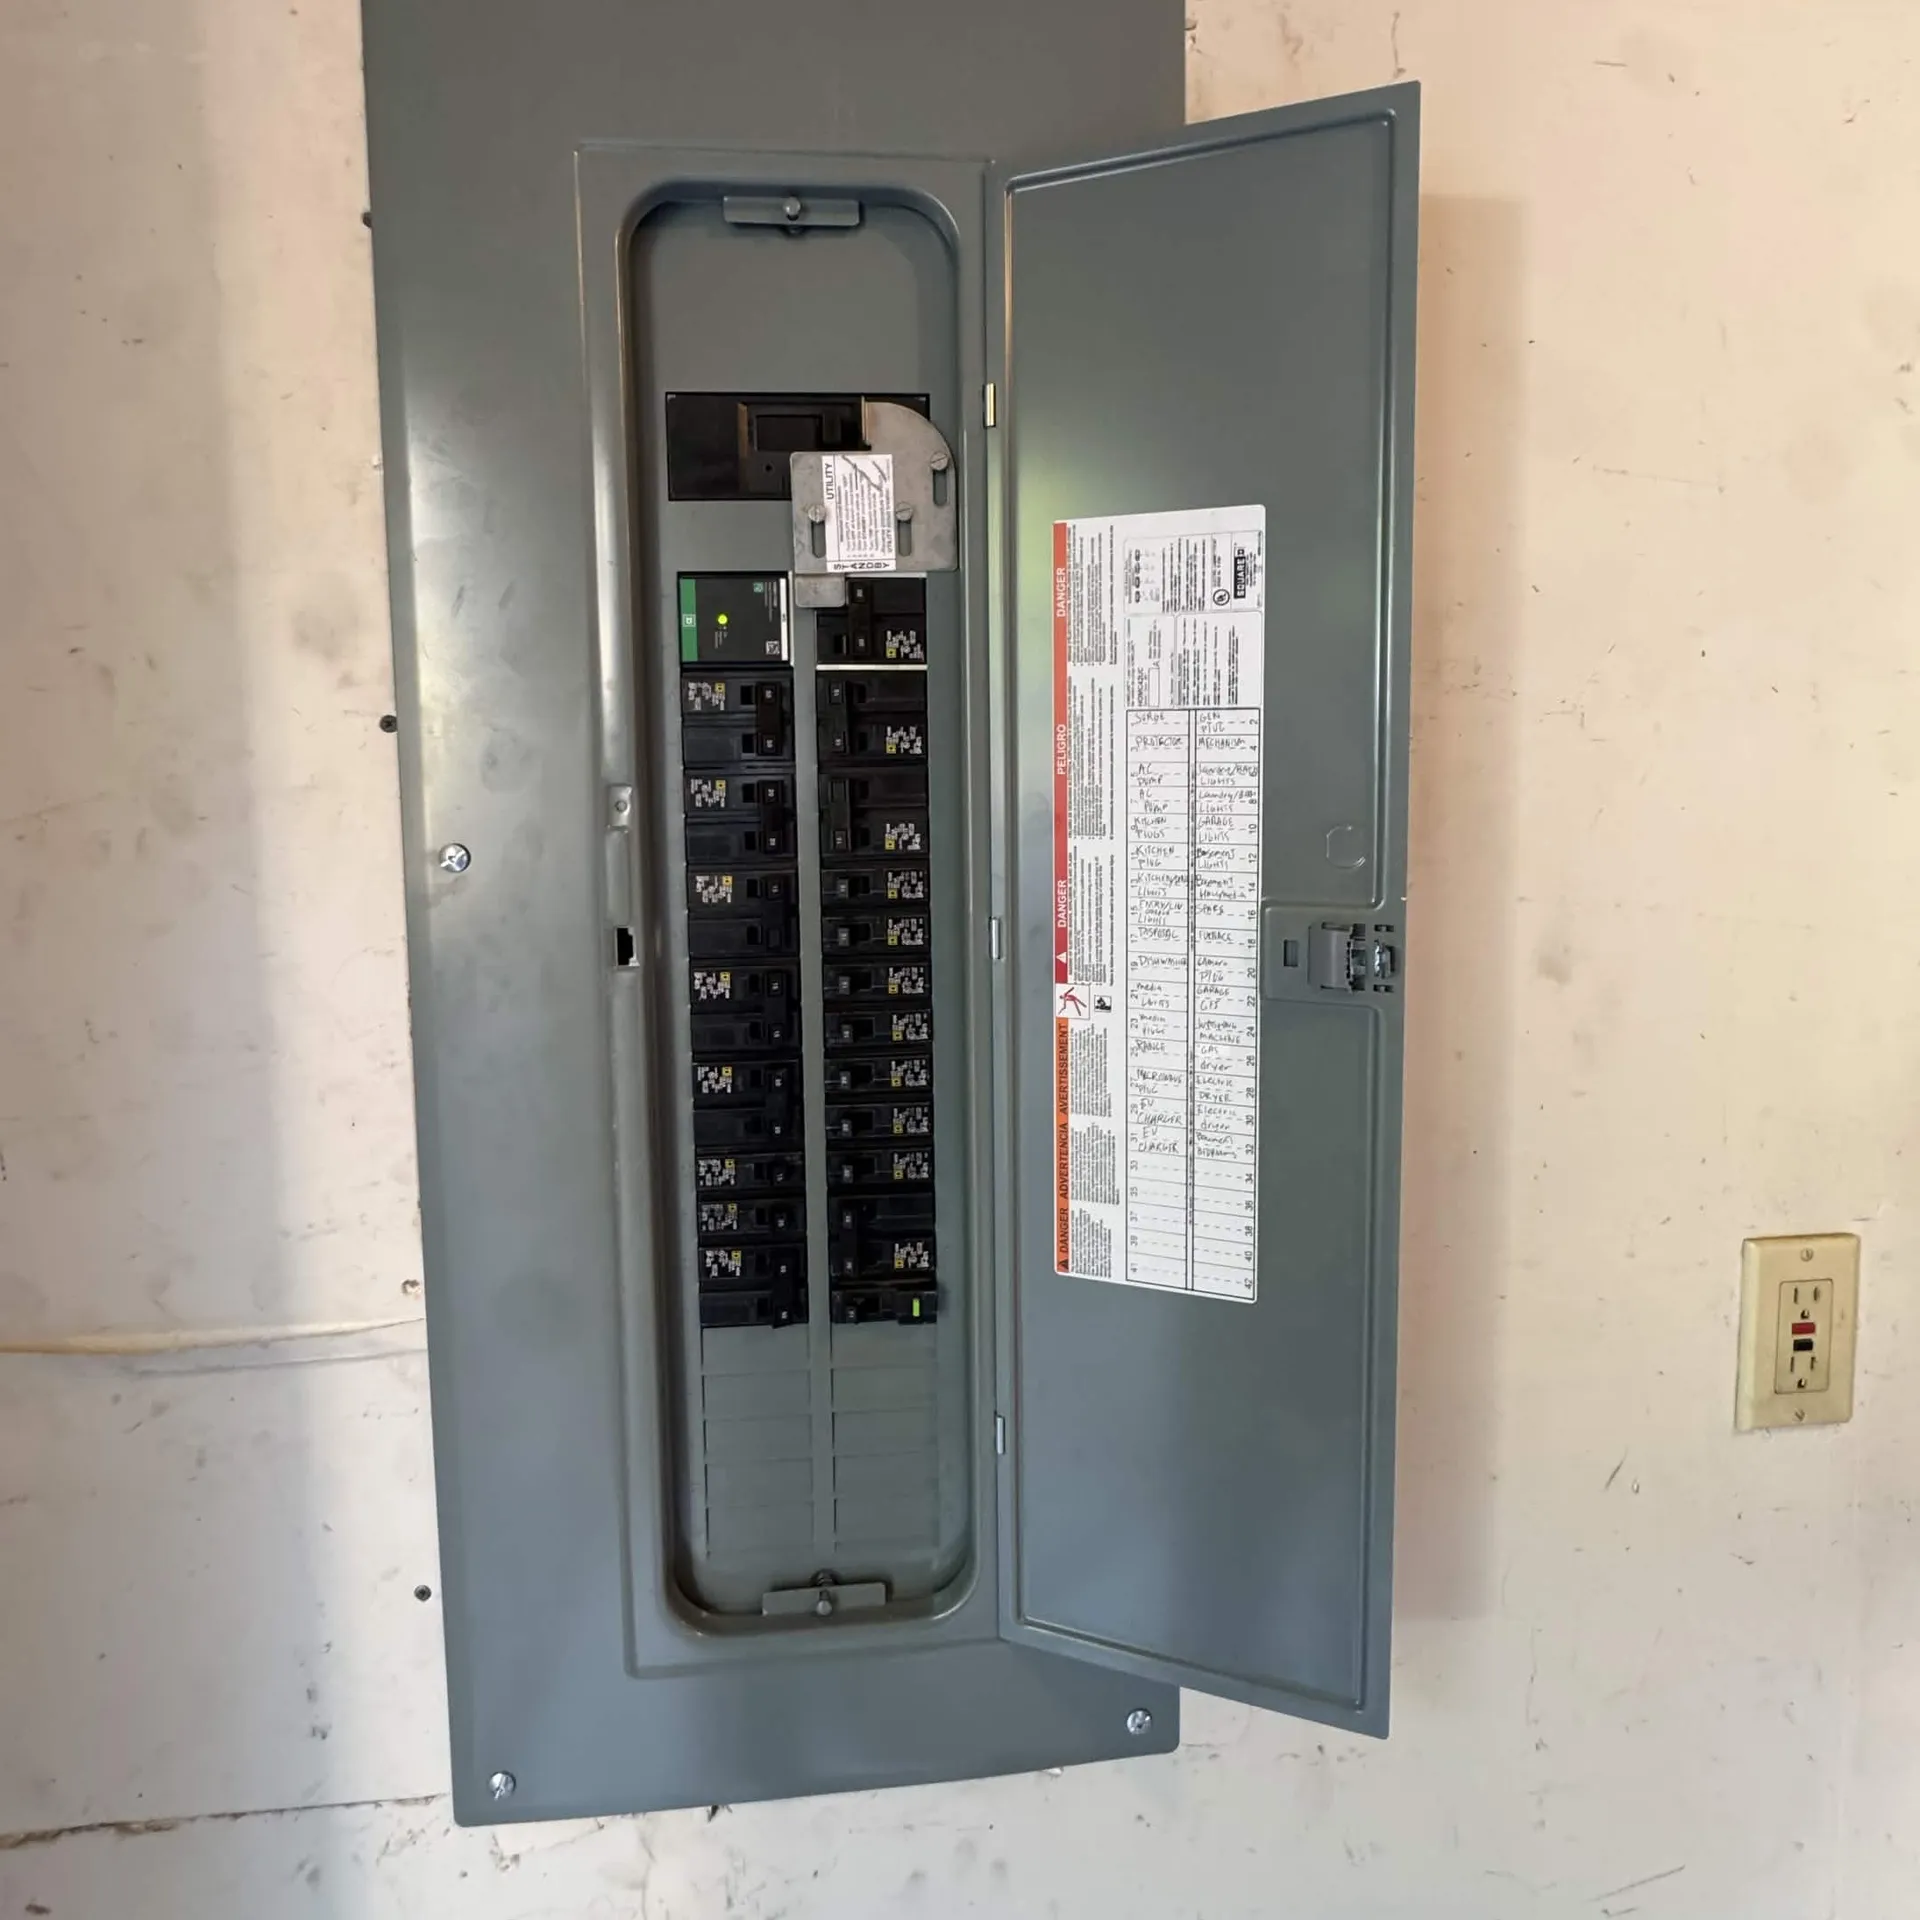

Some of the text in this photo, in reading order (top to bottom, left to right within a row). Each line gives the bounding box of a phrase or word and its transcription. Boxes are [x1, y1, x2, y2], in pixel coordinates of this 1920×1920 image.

[825, 463, 835, 500] UTILITY
[833, 562, 890, 571] STANDBY
[1237, 558, 1245, 597] SQUARE
[1056, 567, 1066, 618] DANGER
[1056, 724, 1066, 775] PELIGRO
[1057, 879, 1067, 928] DANGER
[1247, 967, 1256, 979] 20
[1131, 990, 1139, 999] 21
[1247, 995, 1256, 1007] 22
[1130, 1018, 1139, 1028] 23
[1246, 1026, 1255, 1038] 24
[1058, 1023, 1068, 1253] DANGER ADVERTENCIA AVERTISSEMENT
[1244, 1278, 1253, 1289] 42
